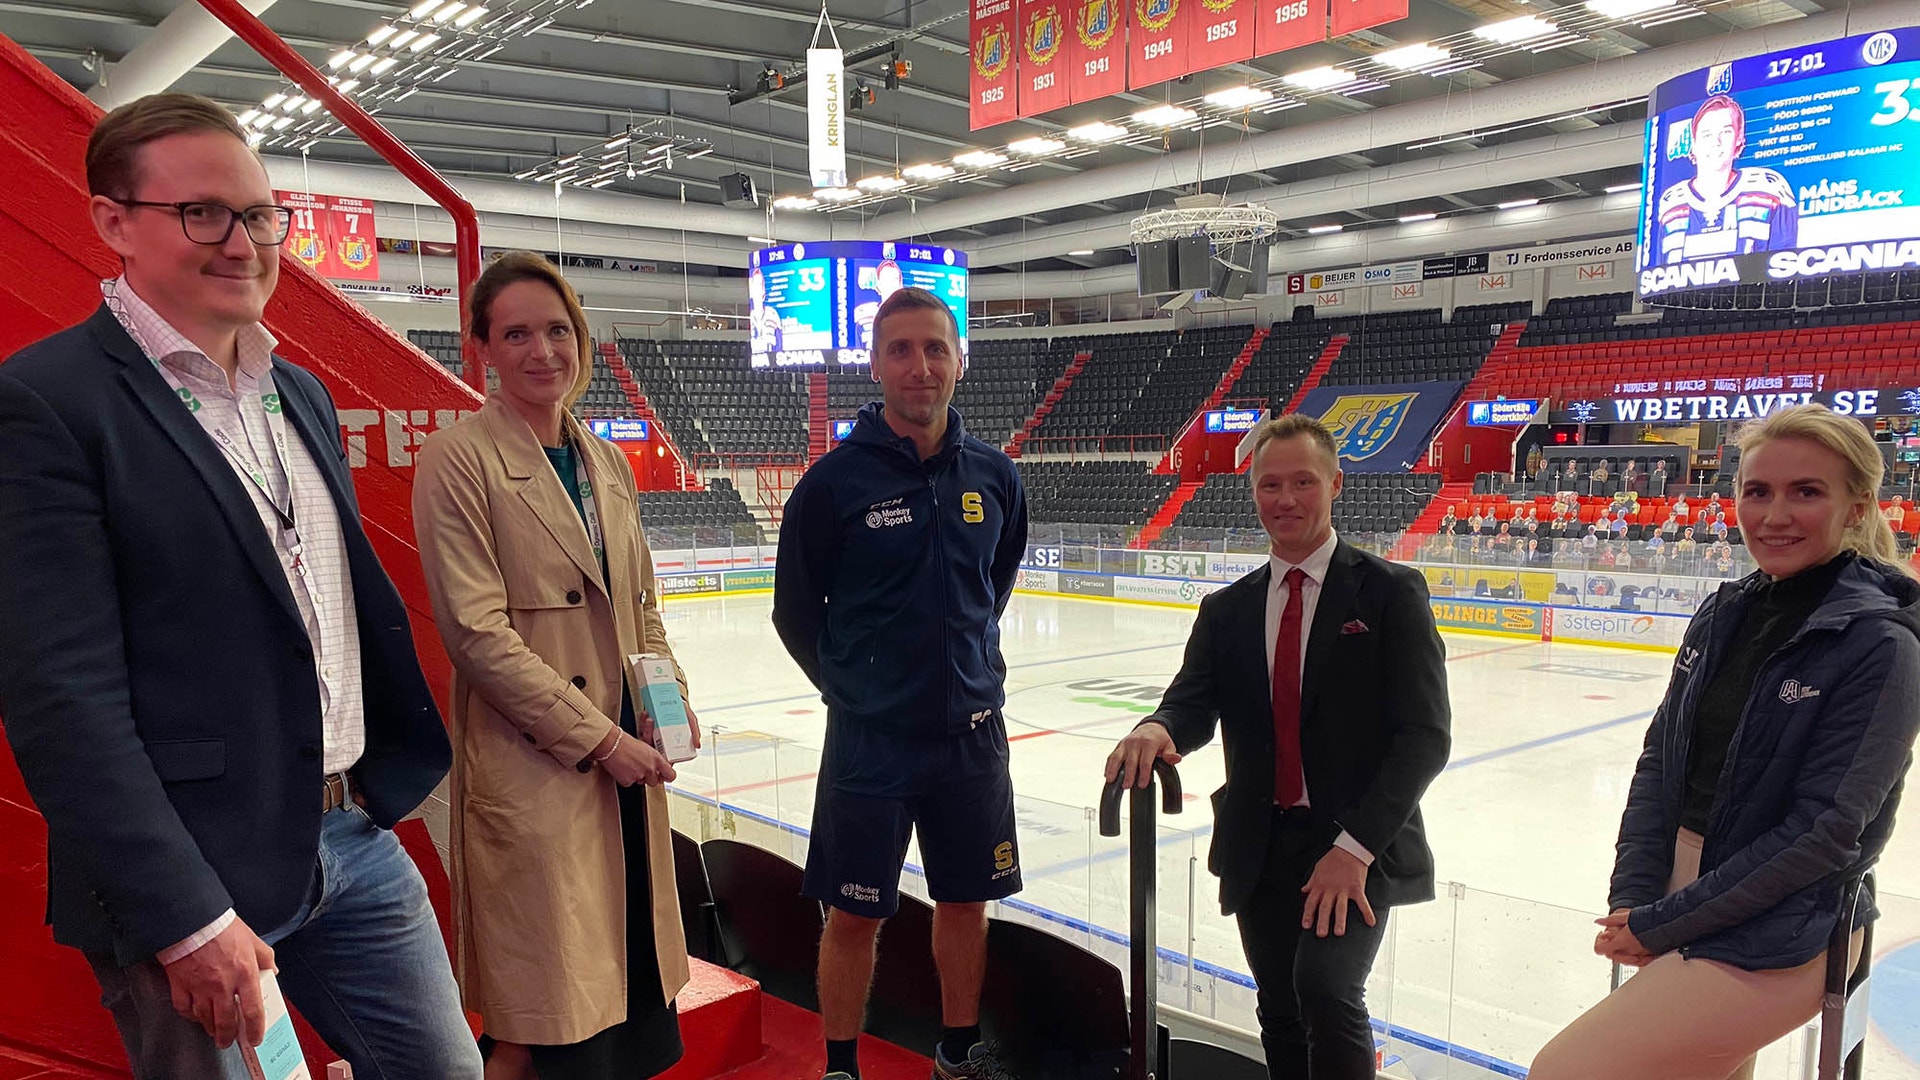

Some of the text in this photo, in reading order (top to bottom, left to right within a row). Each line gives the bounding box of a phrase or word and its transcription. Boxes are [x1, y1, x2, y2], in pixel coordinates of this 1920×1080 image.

[1275, 2, 1308, 24] 1956
[1206, 19, 1237, 42] 1953
[1144, 38, 1173, 61] 1944
[1084, 56, 1109, 76] 1941
[1767, 52, 1826, 79] 17:01
[1033, 72, 1055, 91] 1931
[981, 86, 1004, 105] 1925
[1813, 86, 1860, 100] FORWARD
[827, 73, 838, 146] KRINGLAN
[1754, 147, 1789, 159] SHOOTS
[1800, 178, 1858, 202] MÅNS
[294, 209, 315, 230] 11
[345, 214, 359, 234] 7
[1467, 256, 1478, 269] JB
[1506, 242, 1633, 266] TJ Fordonsservice AB
[1767, 239, 1920, 279] SCANIA
[798, 267, 825, 292] 33
[1291, 277, 1300, 291] S
[1325, 271, 1356, 283] BEIJER
[1639, 258, 1741, 295] SCANIA
[1832, 389, 1880, 416] SE
[869, 497, 904, 510] CCM
[881, 507, 911, 518] Monkey
[961, 492, 985, 524] S
[883, 514, 913, 527] Sports
[1144, 554, 1202, 576] BST
[993, 840, 1014, 870] S
[991, 865, 1018, 880] CCM
[854, 884, 880, 894] Monkey
[854, 892, 880, 902] Sports
